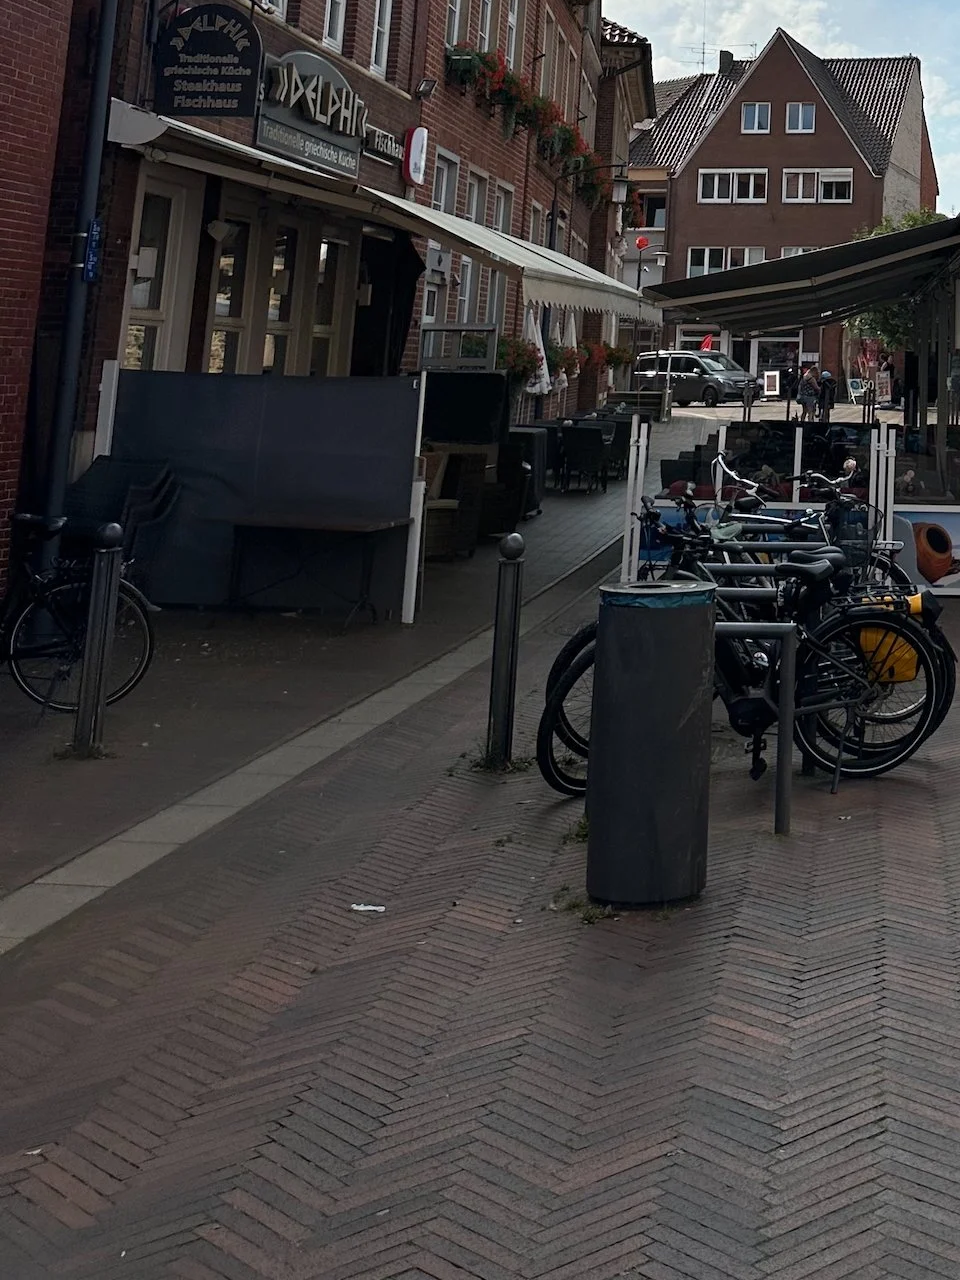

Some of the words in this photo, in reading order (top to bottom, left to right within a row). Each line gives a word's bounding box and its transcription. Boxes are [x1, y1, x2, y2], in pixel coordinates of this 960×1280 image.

[179, 53, 239, 64] Traditionelle
[164, 65, 219, 76] griechische
[173, 80, 242, 92] Steakhaus
[173, 95, 238, 108] Fischhaus
[263, 121, 304, 150] Traditionelle
[305, 138, 338, 163] griechische
